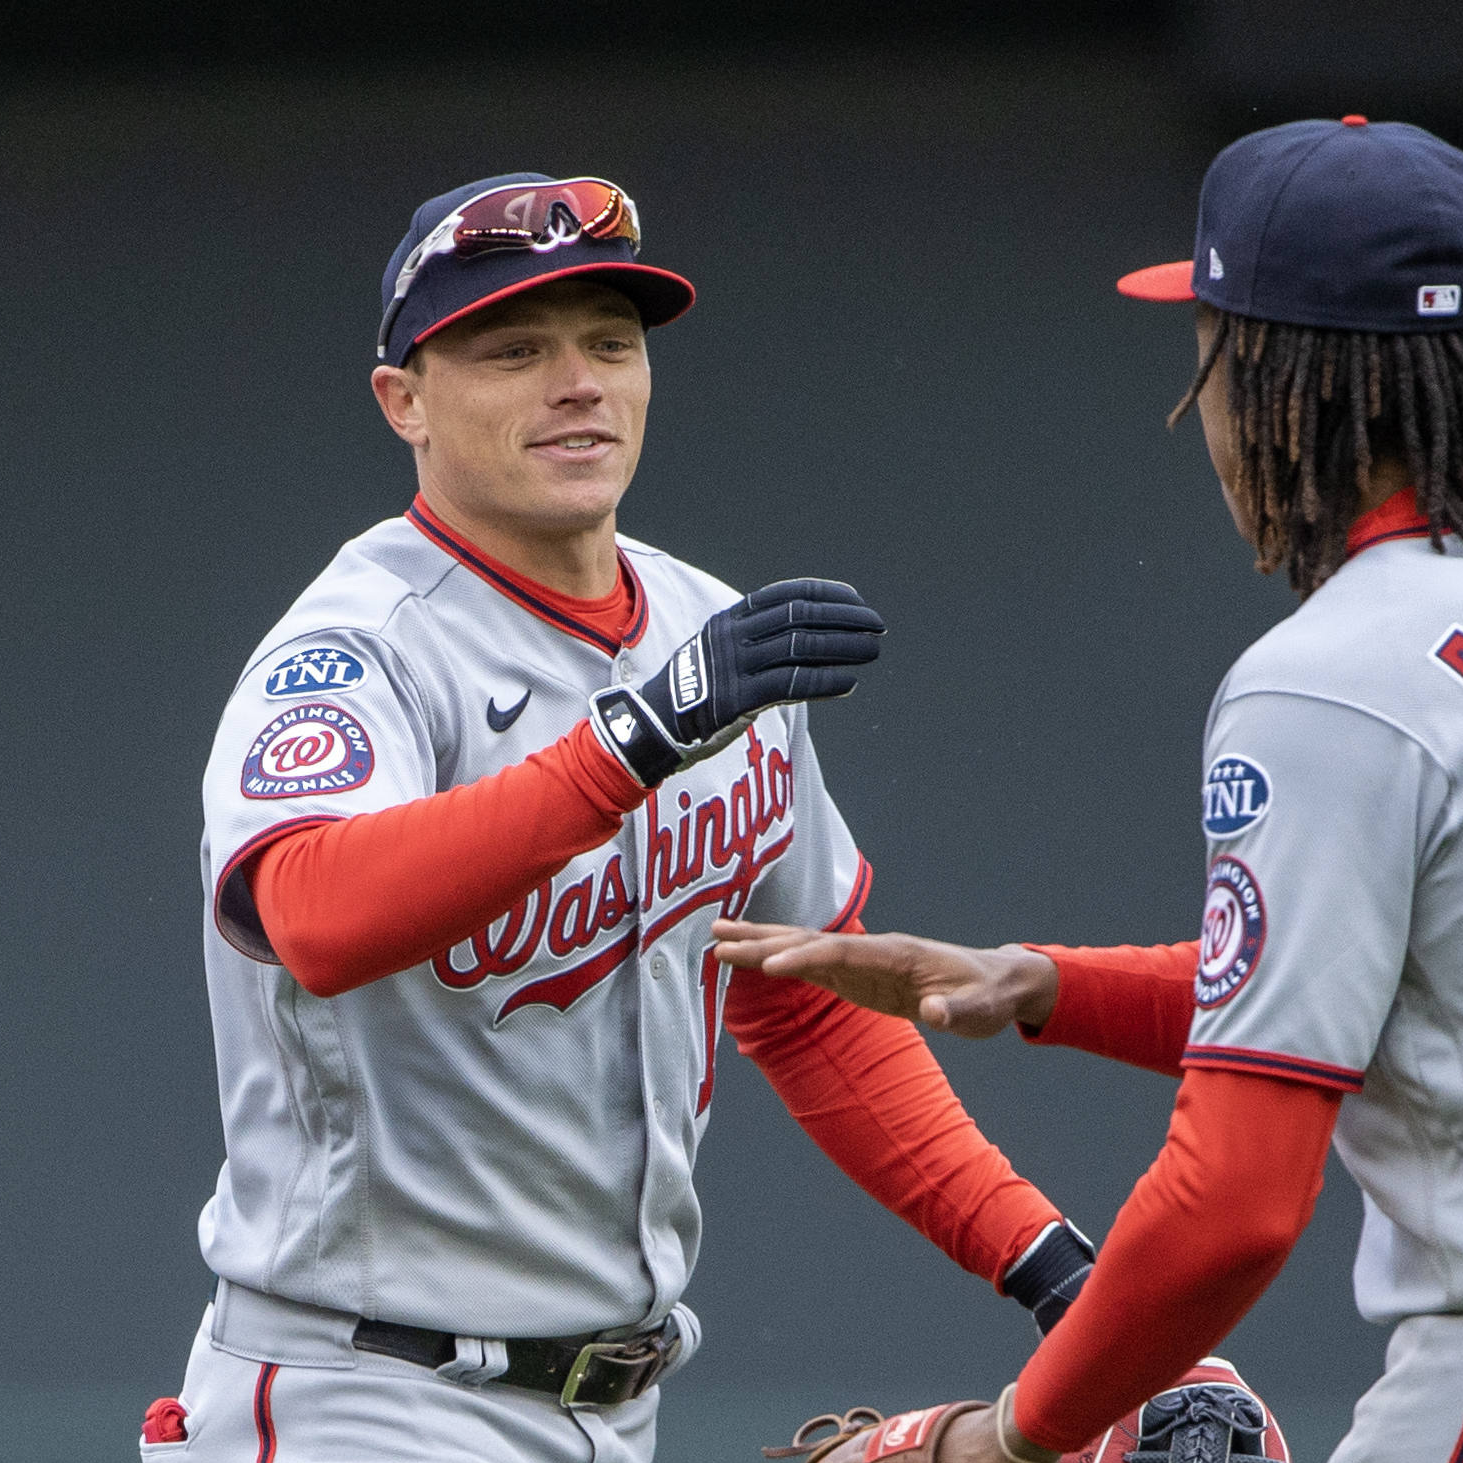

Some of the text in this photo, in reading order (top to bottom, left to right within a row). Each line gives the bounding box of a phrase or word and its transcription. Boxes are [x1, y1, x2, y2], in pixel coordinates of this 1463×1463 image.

[269, 660, 359, 693] TNL
[249, 706, 368, 758] WASHINGTON
[246, 770, 355, 793] NATIONALS
